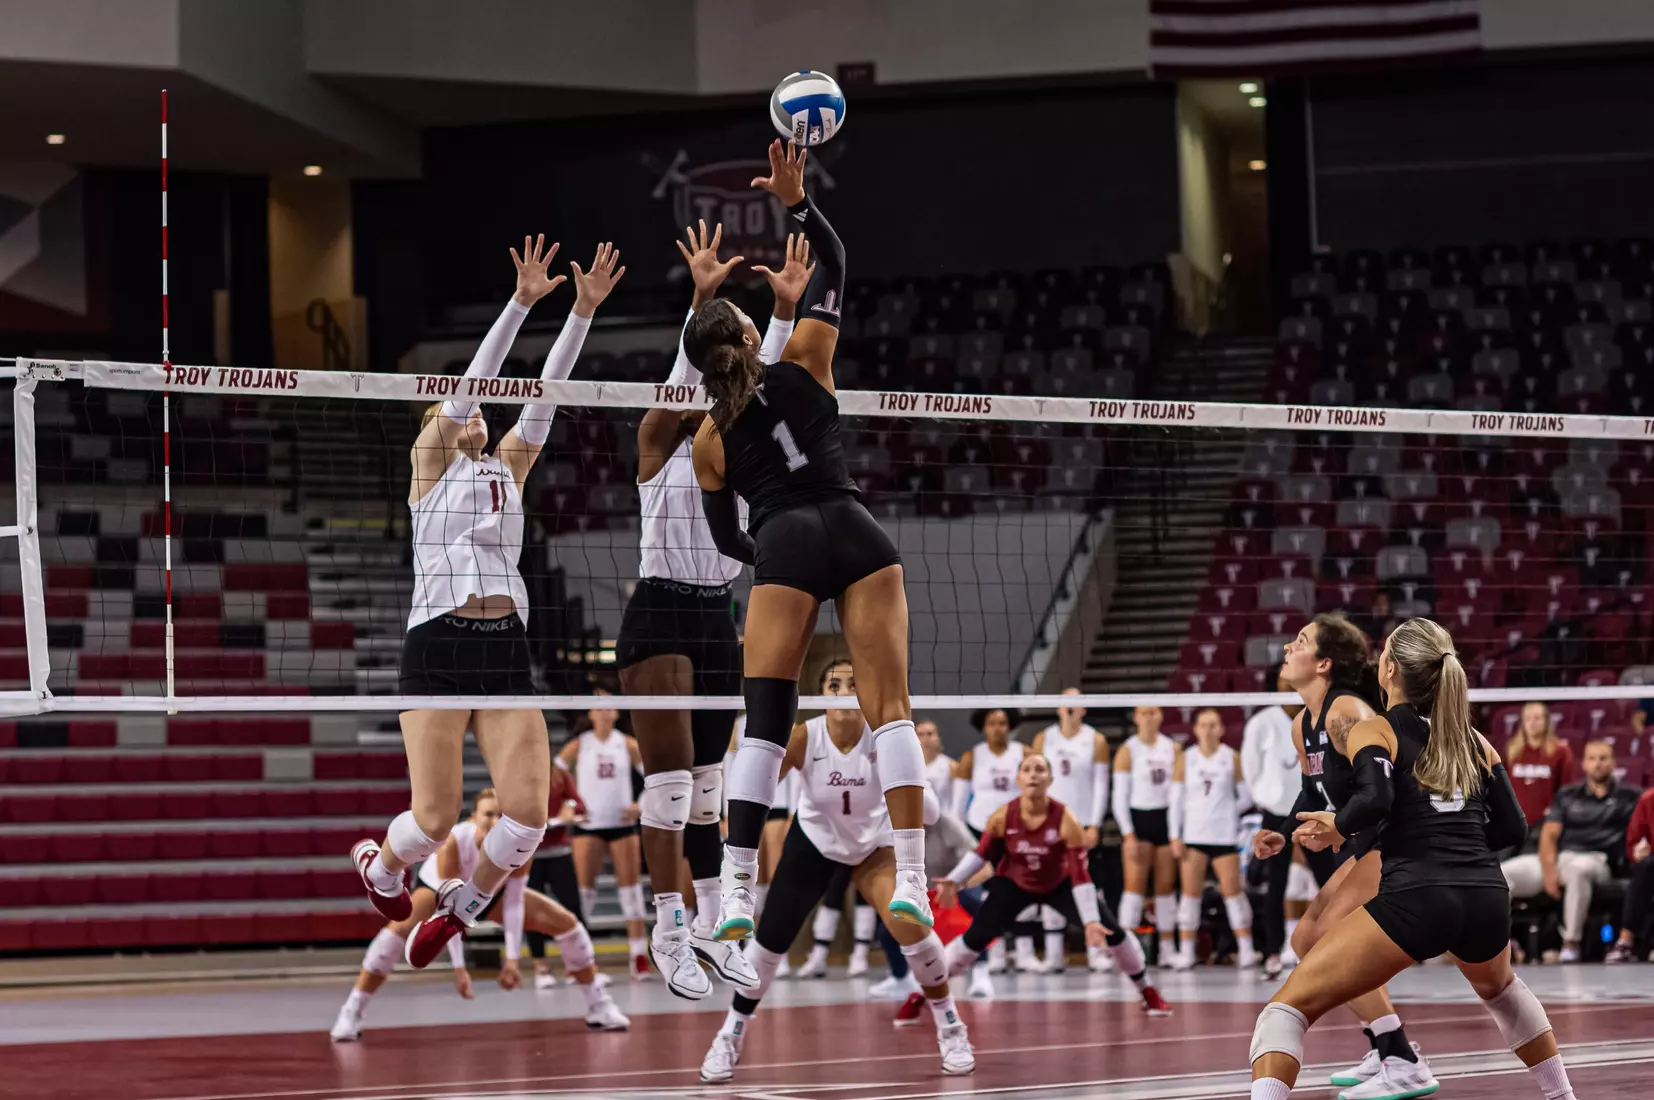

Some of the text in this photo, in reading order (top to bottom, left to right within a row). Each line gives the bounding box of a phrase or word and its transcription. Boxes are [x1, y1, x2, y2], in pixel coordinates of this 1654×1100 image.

[164, 366, 298, 389] TROY TROJANS
[415, 376, 543, 398] TROY TROJANS
[654, 385, 697, 403] TROY
[879, 393, 992, 413] TROY TROJANS
[1089, 401, 1196, 420] TROY TROJANS
[1287, 407, 1386, 426] TROY TROJANS
[1472, 414, 1564, 432] TROY TROJANS
[771, 420, 809, 472] 1
[472, 620, 509, 631] NIKE
[827, 772, 866, 787] Bama
[842, 791, 851, 815] 1
